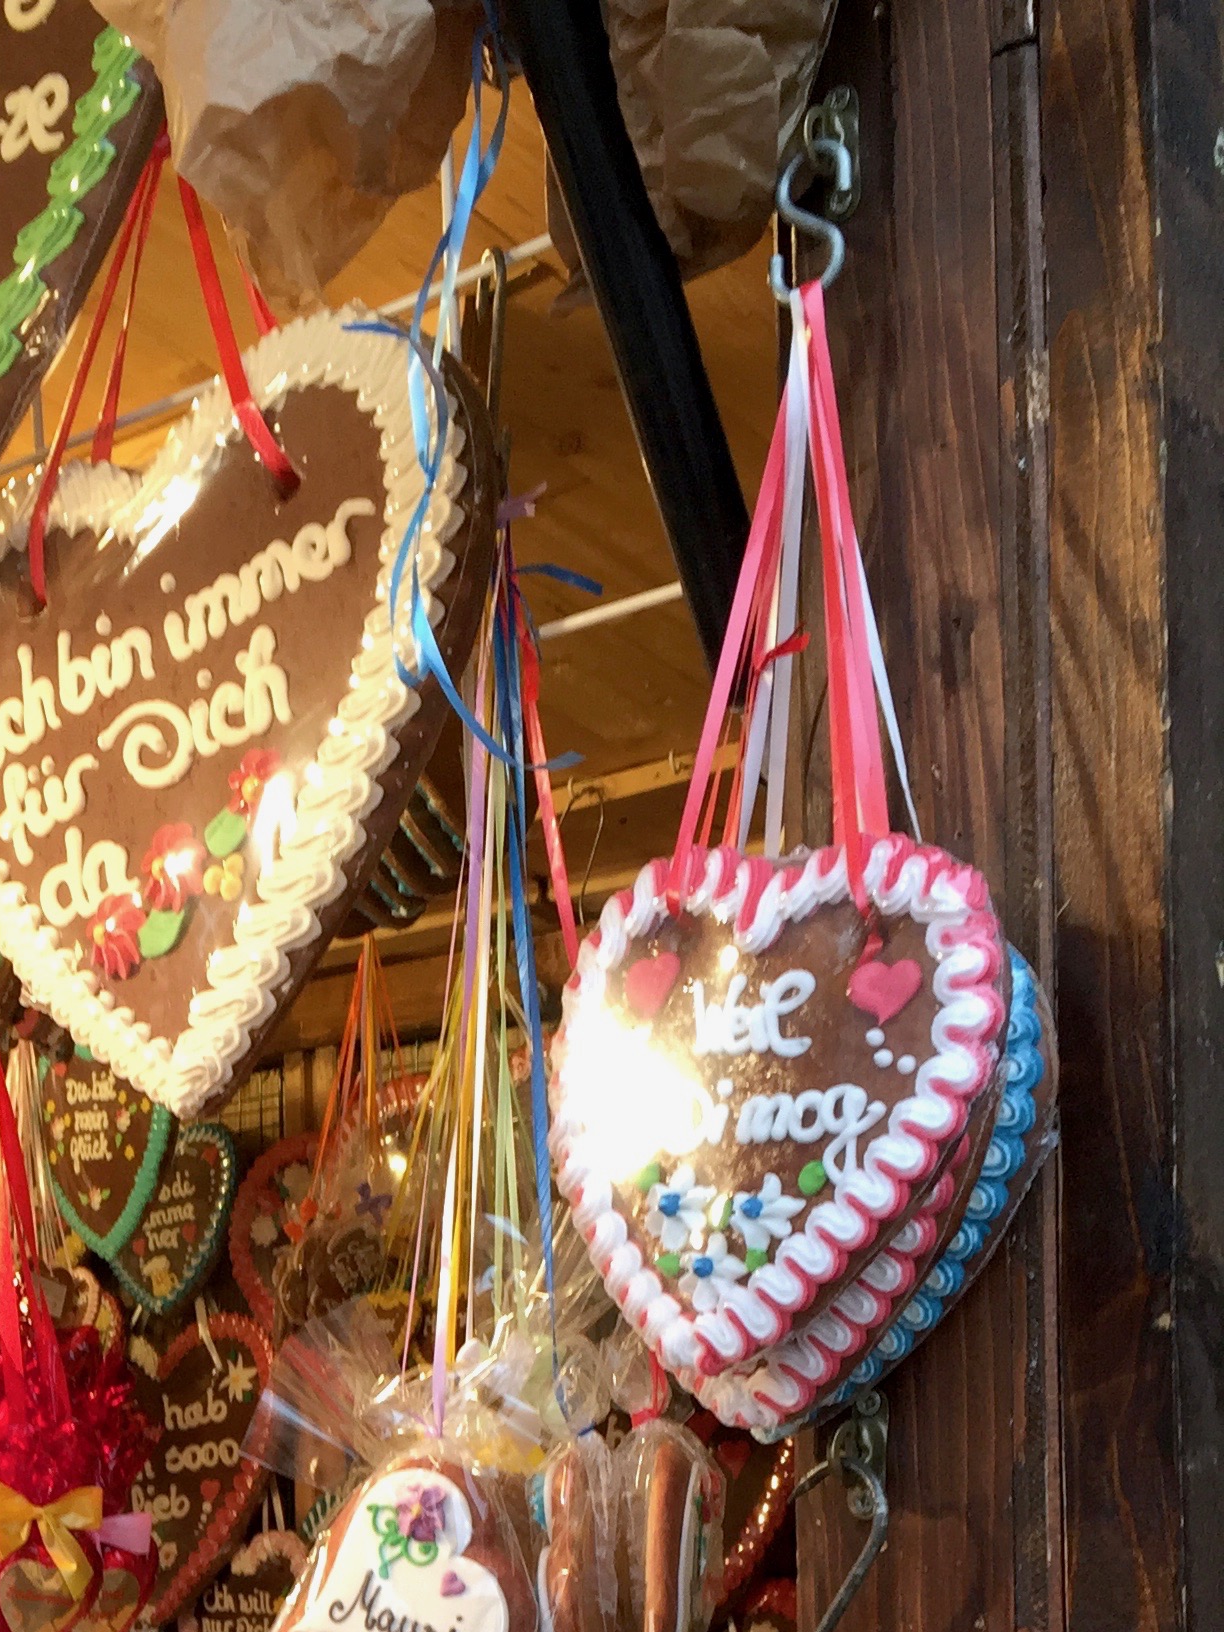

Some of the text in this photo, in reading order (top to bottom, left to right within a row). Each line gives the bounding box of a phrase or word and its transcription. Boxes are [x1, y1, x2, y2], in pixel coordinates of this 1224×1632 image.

[163, 497, 376, 662] immer
[98, 624, 293, 789] Dich
[40, 825, 140, 926] da
[735, 1083, 887, 1184] mog
[162, 1387, 228, 1431] hab
